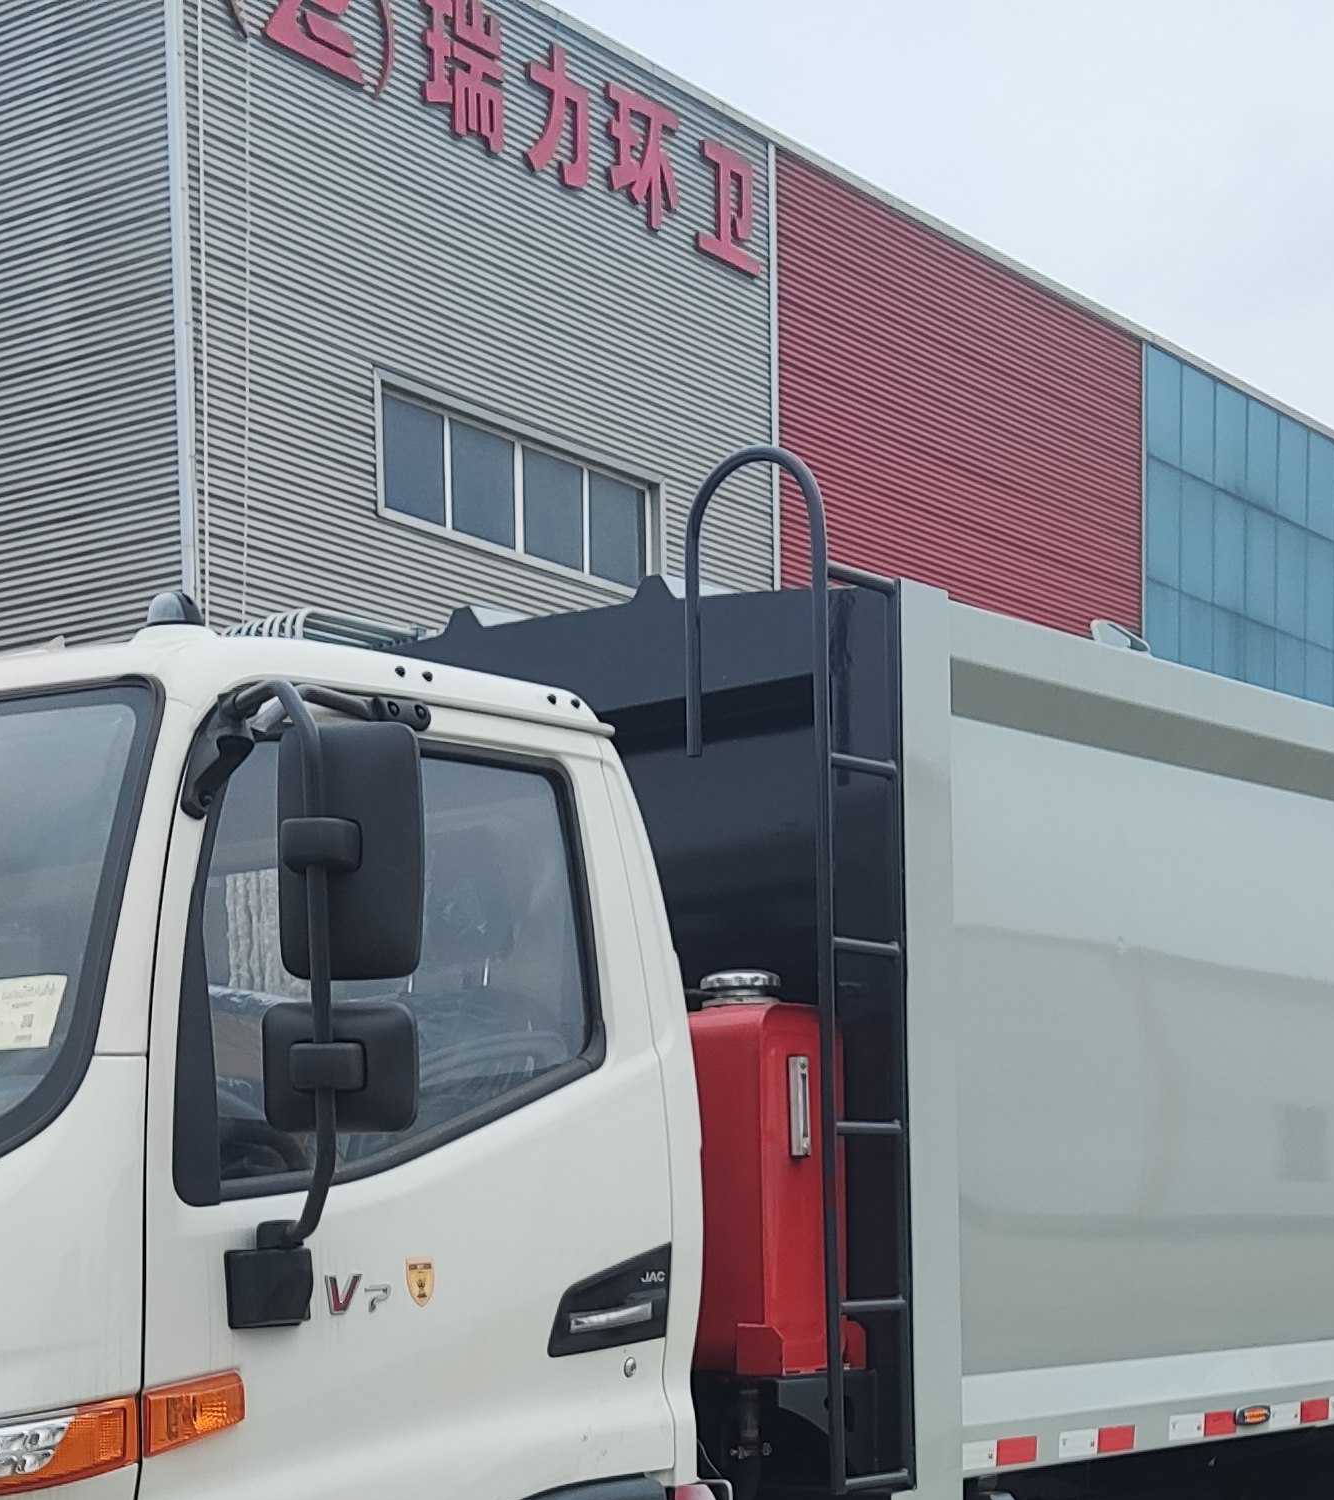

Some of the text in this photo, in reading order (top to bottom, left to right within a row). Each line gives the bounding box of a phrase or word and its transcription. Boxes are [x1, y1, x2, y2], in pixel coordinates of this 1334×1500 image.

[422, 0, 762, 277] 瑞力环卫
[640, 1270, 666, 1283] JAC
